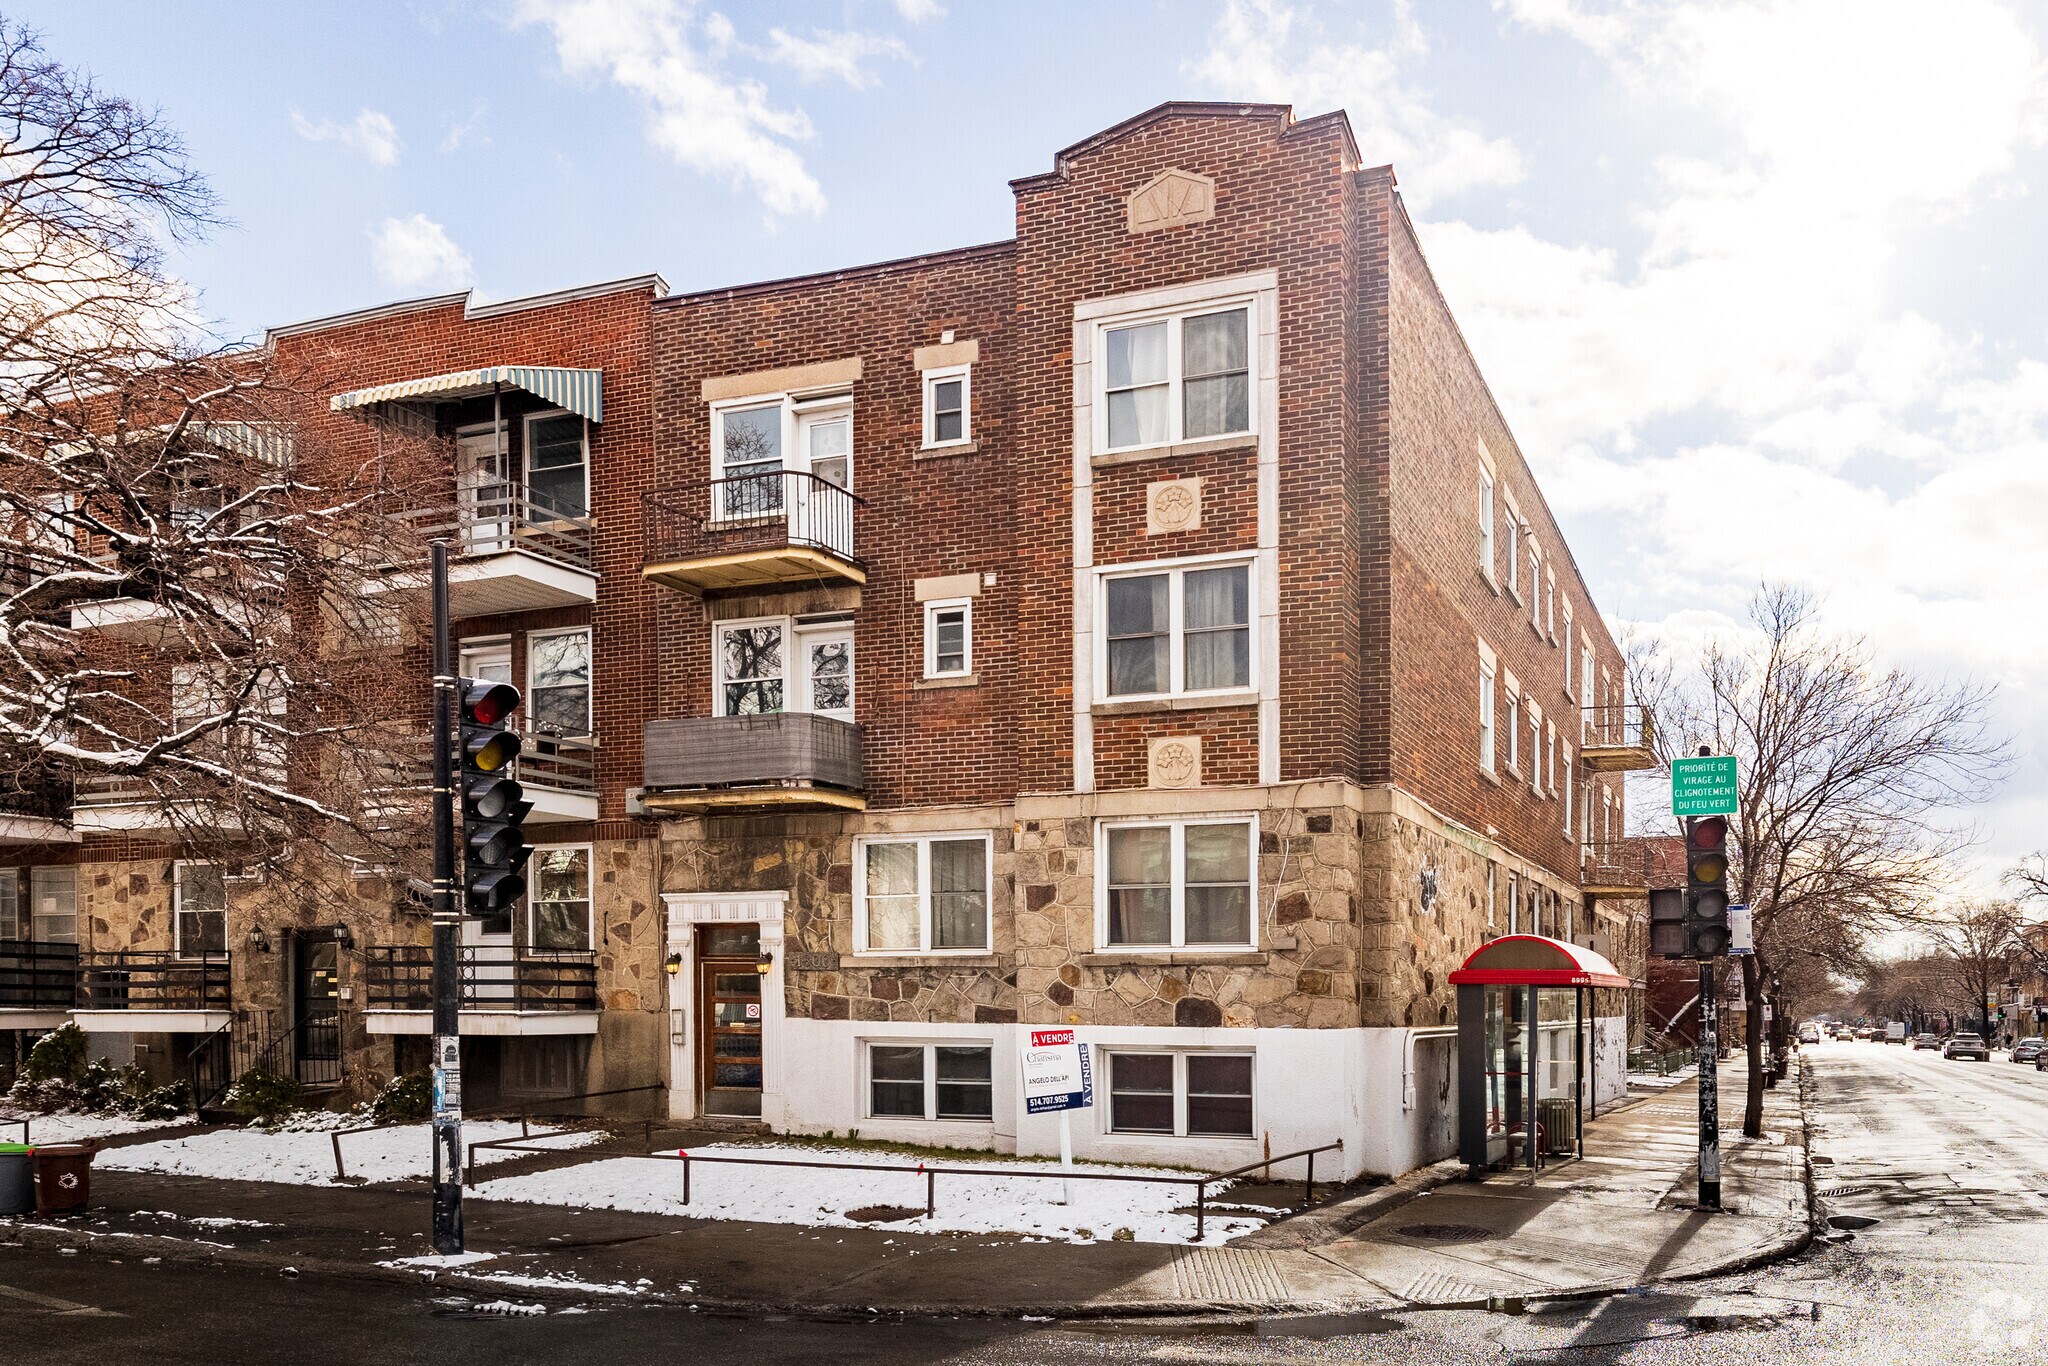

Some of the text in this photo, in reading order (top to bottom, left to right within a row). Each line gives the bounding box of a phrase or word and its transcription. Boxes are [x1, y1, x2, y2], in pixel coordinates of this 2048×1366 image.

[1718, 762, 1729, 771] DE
[1683, 775, 1726, 785] VIRAGE AU
[1674, 787, 1735, 798] CLIGNOTEMENT
[1678, 799, 1730, 809] DU FEU VERT
[1040, 1033, 1074, 1044] VENDRE
[1080, 1045, 1092, 1093] VENDRE
[1030, 1095, 1069, 1106] 514.707.9525
